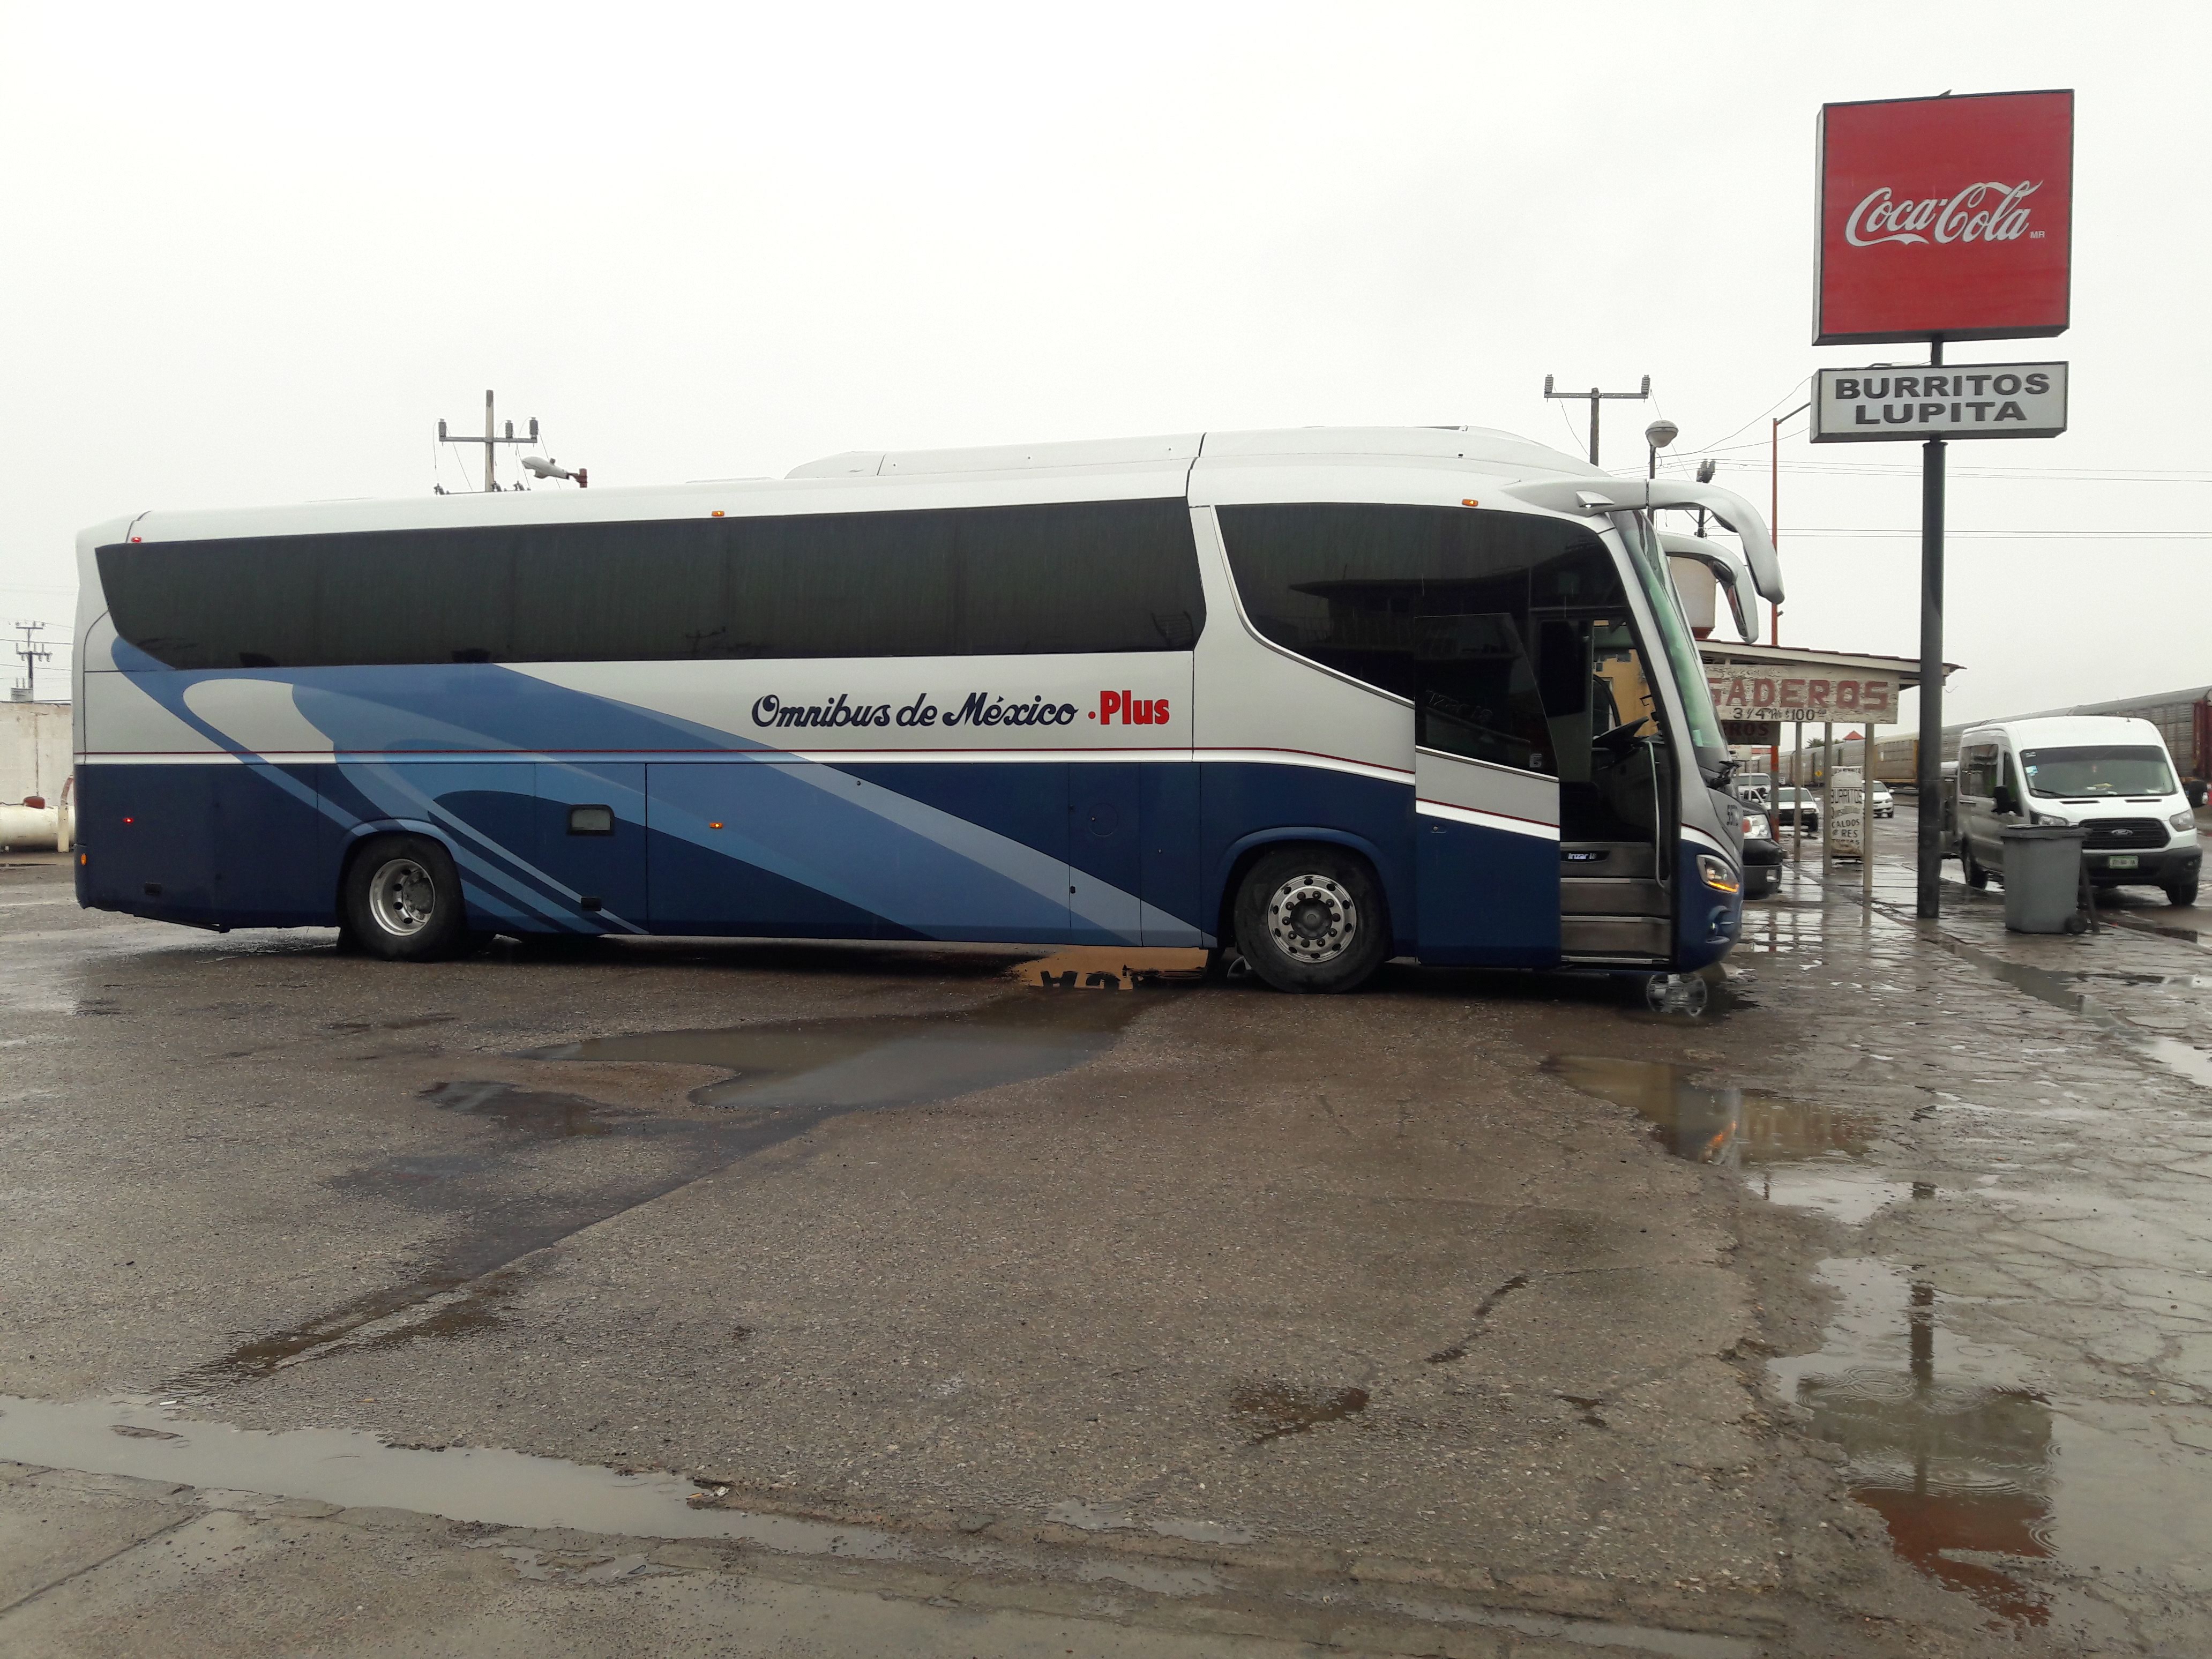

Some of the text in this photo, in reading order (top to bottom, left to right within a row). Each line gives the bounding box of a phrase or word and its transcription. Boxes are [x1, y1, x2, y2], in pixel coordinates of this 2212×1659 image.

[1845, 180, 2045, 247] Coca-Cola MR
[1836, 373, 2050, 399] BURRITOS
[1856, 401, 2027, 424] LUPITA
[752, 693, 891, 727] Omnibus
[896, 692, 938, 727] de
[941, 692, 1079, 726] México
[1832, 819, 1860, 828] CALDOS
[1841, 829, 1858, 838] RES
